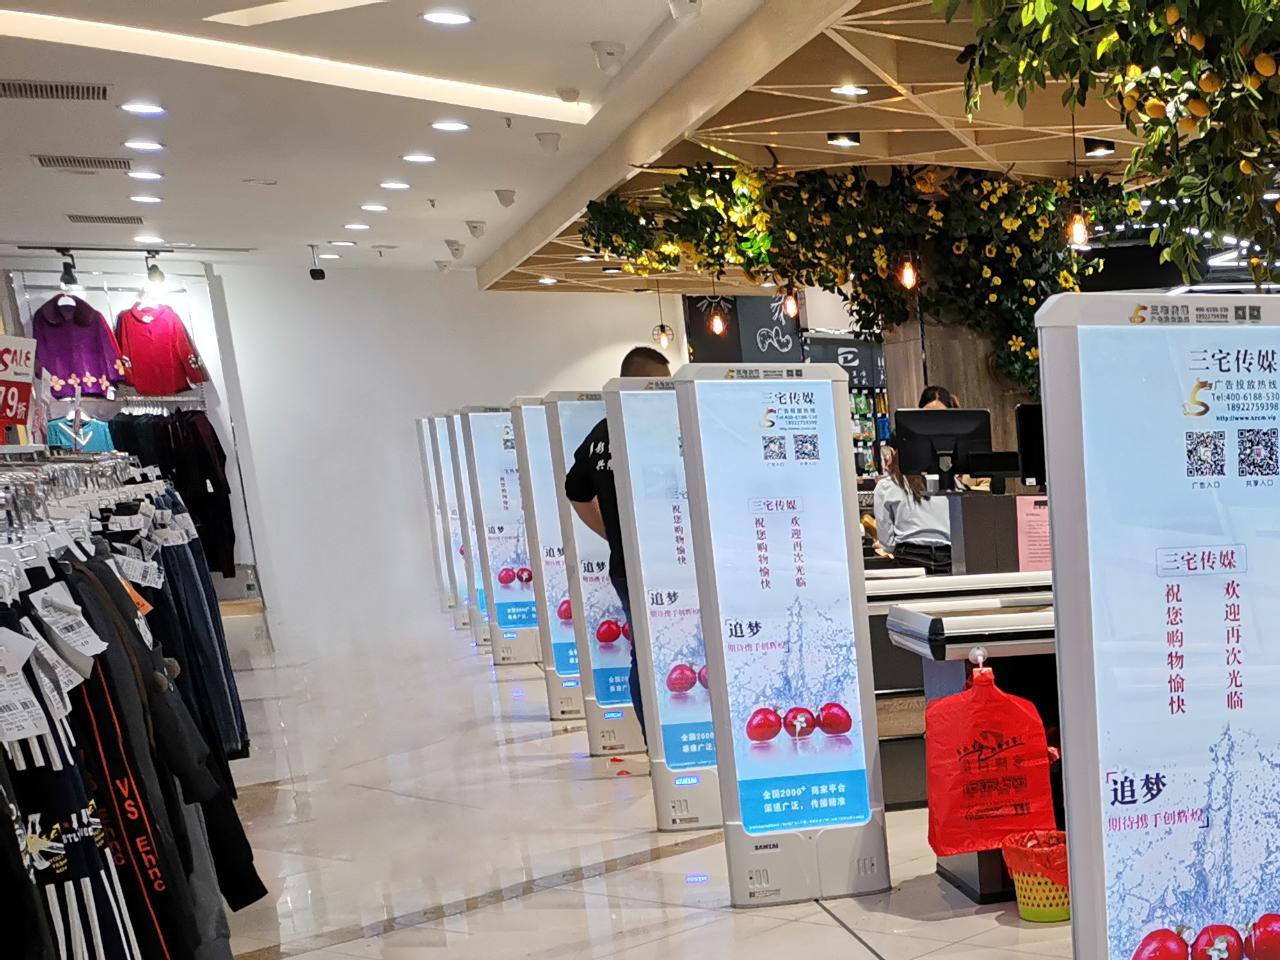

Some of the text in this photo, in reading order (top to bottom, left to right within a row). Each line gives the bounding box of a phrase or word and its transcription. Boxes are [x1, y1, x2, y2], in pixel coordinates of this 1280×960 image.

[1189, 349, 1278, 374] 三宅传媒
[1214, 379, 1278, 391] 广告投放热线
[761, 391, 816, 405] 三宅传媒
[1226, 402, 1279, 412] 18922759398
[752, 499, 798, 512] 三宅传媒
[755, 517, 772, 590] 祝您购物愉快
[1161, 549, 1238, 573] 三宅传媒
[582, 560, 608, 574] 追梦
[650, 590, 680, 607] 追梦
[728, 620, 763, 639] 追梦
[1165, 583, 1187, 716] 祝您购物愉快
[1223, 579, 1244, 710] 欢迎再次光临
[1109, 772, 1168, 807] 追梦
